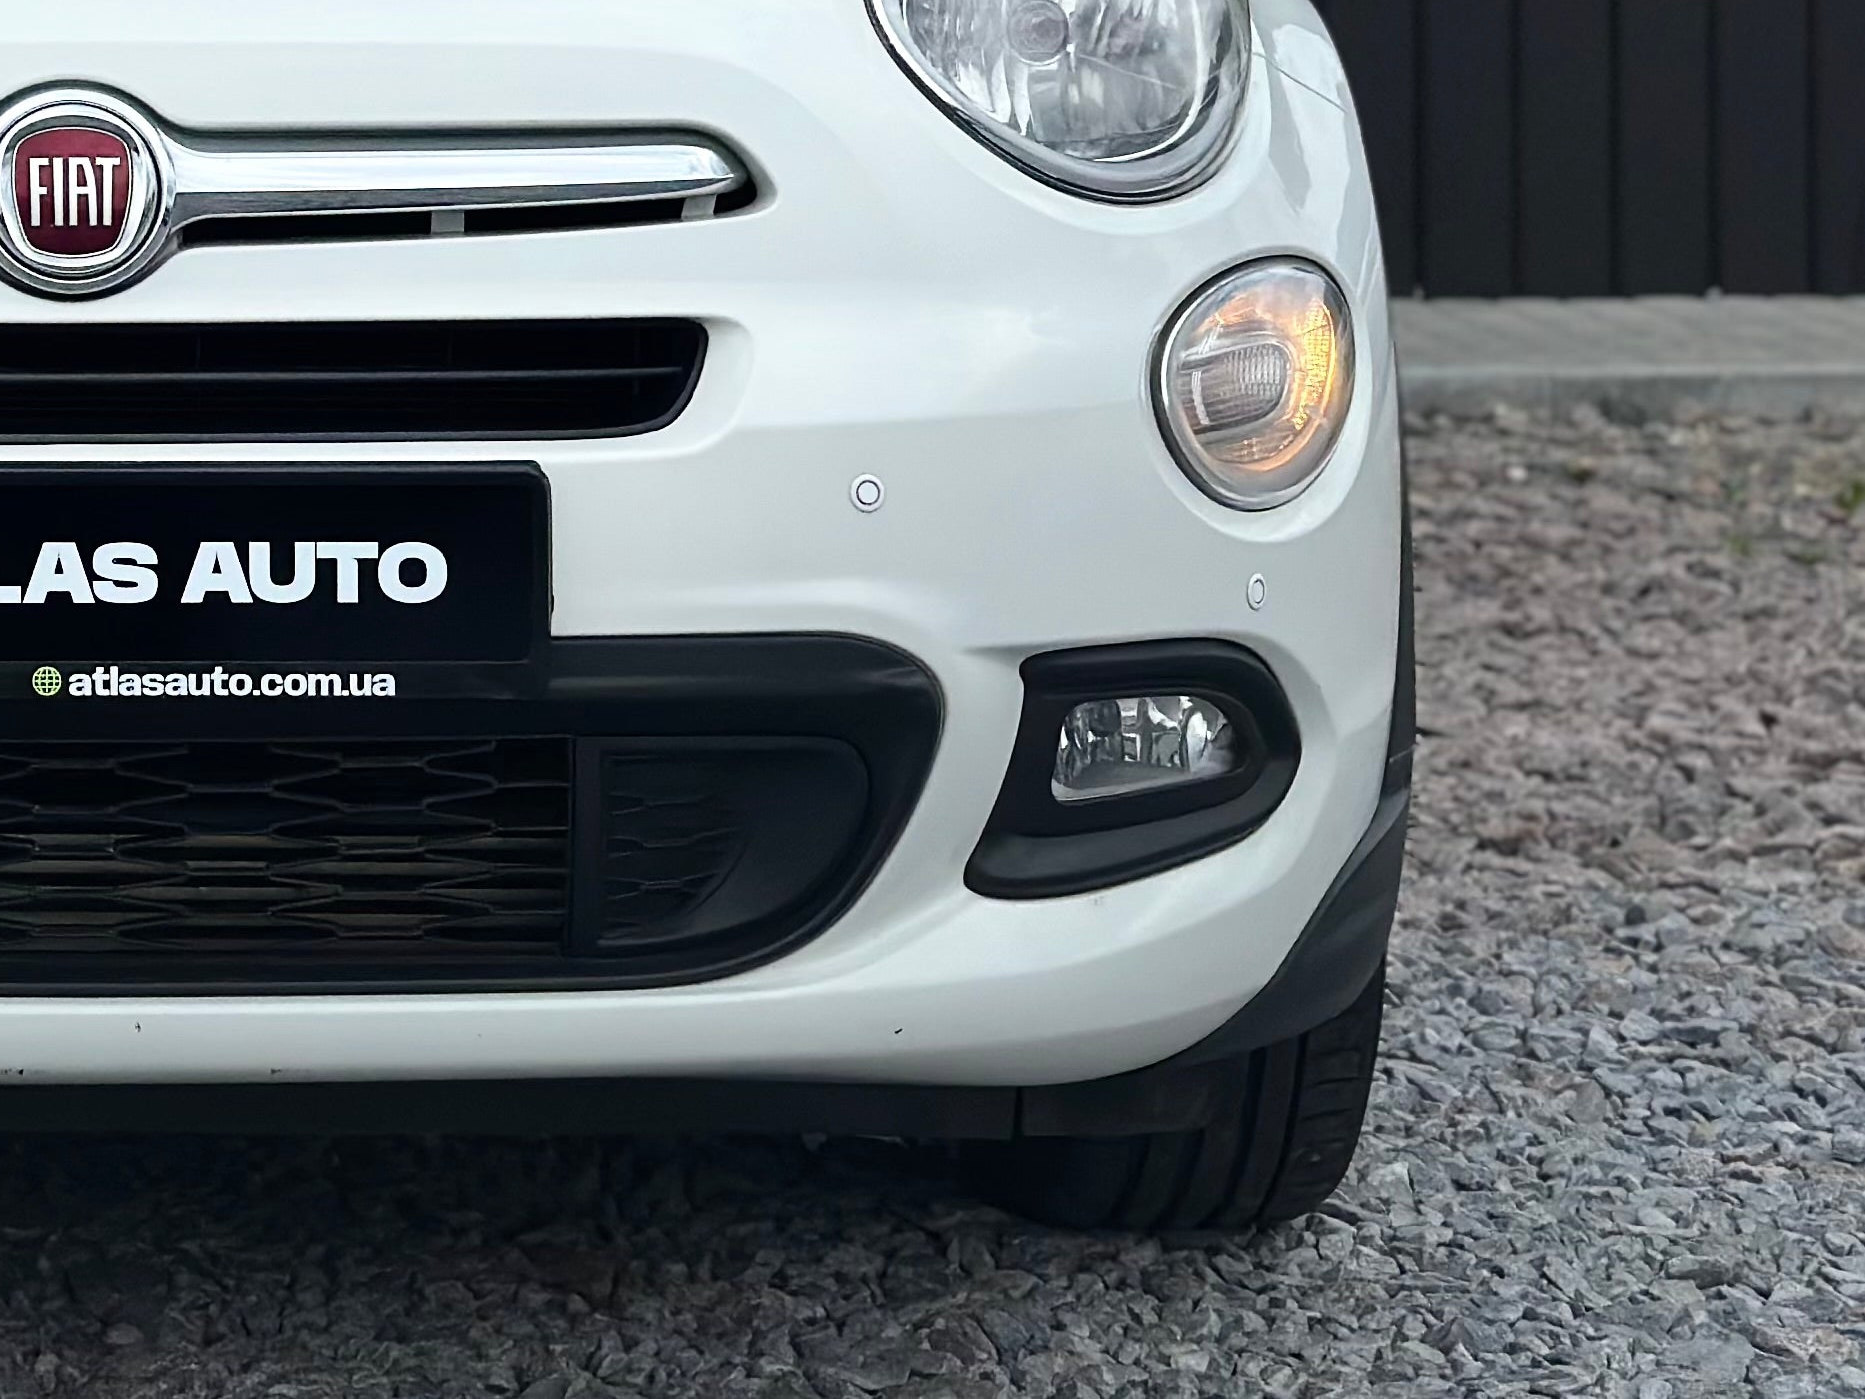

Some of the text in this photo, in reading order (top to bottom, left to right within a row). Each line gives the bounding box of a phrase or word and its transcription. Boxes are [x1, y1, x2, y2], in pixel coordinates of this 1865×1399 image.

[28, 156, 121, 228] FIAT
[181, 541, 448, 604] AUTO
[68, 665, 396, 697] atlasauto.com.ua
